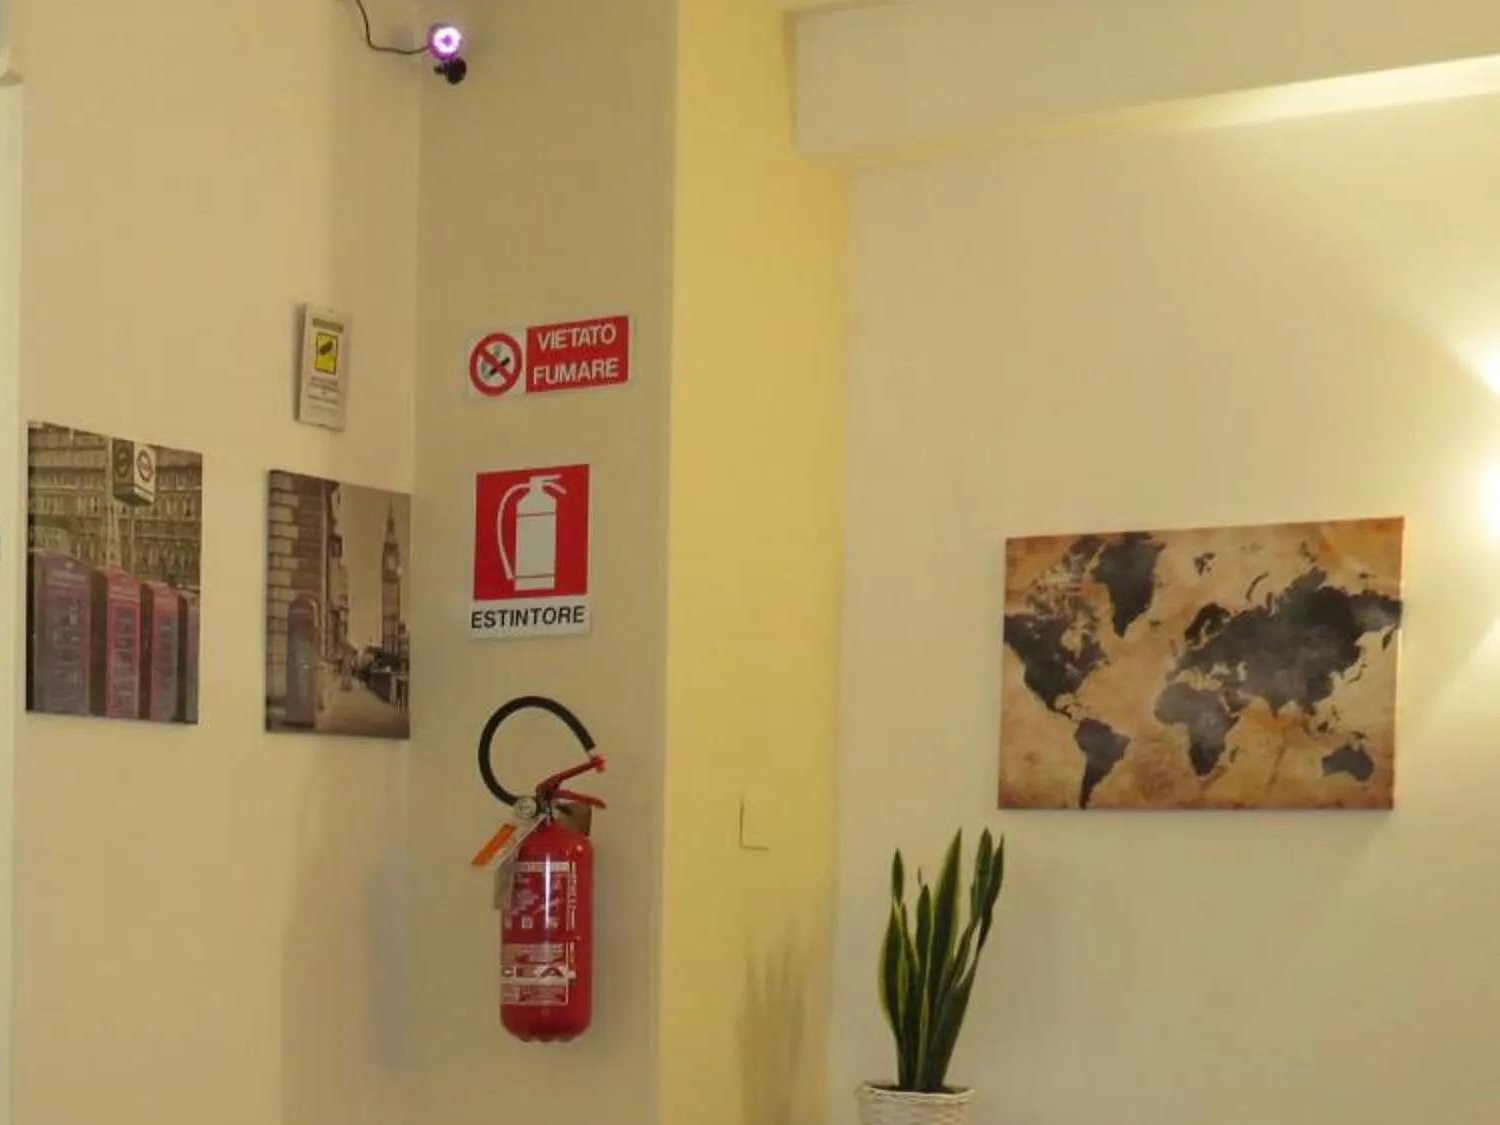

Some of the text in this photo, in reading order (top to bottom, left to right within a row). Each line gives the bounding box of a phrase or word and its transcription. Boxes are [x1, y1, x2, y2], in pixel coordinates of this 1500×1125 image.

[536, 322, 617, 353] VIETATO
[532, 356, 619, 386] FUMARE
[471, 605, 586, 630] ESTINTORE
